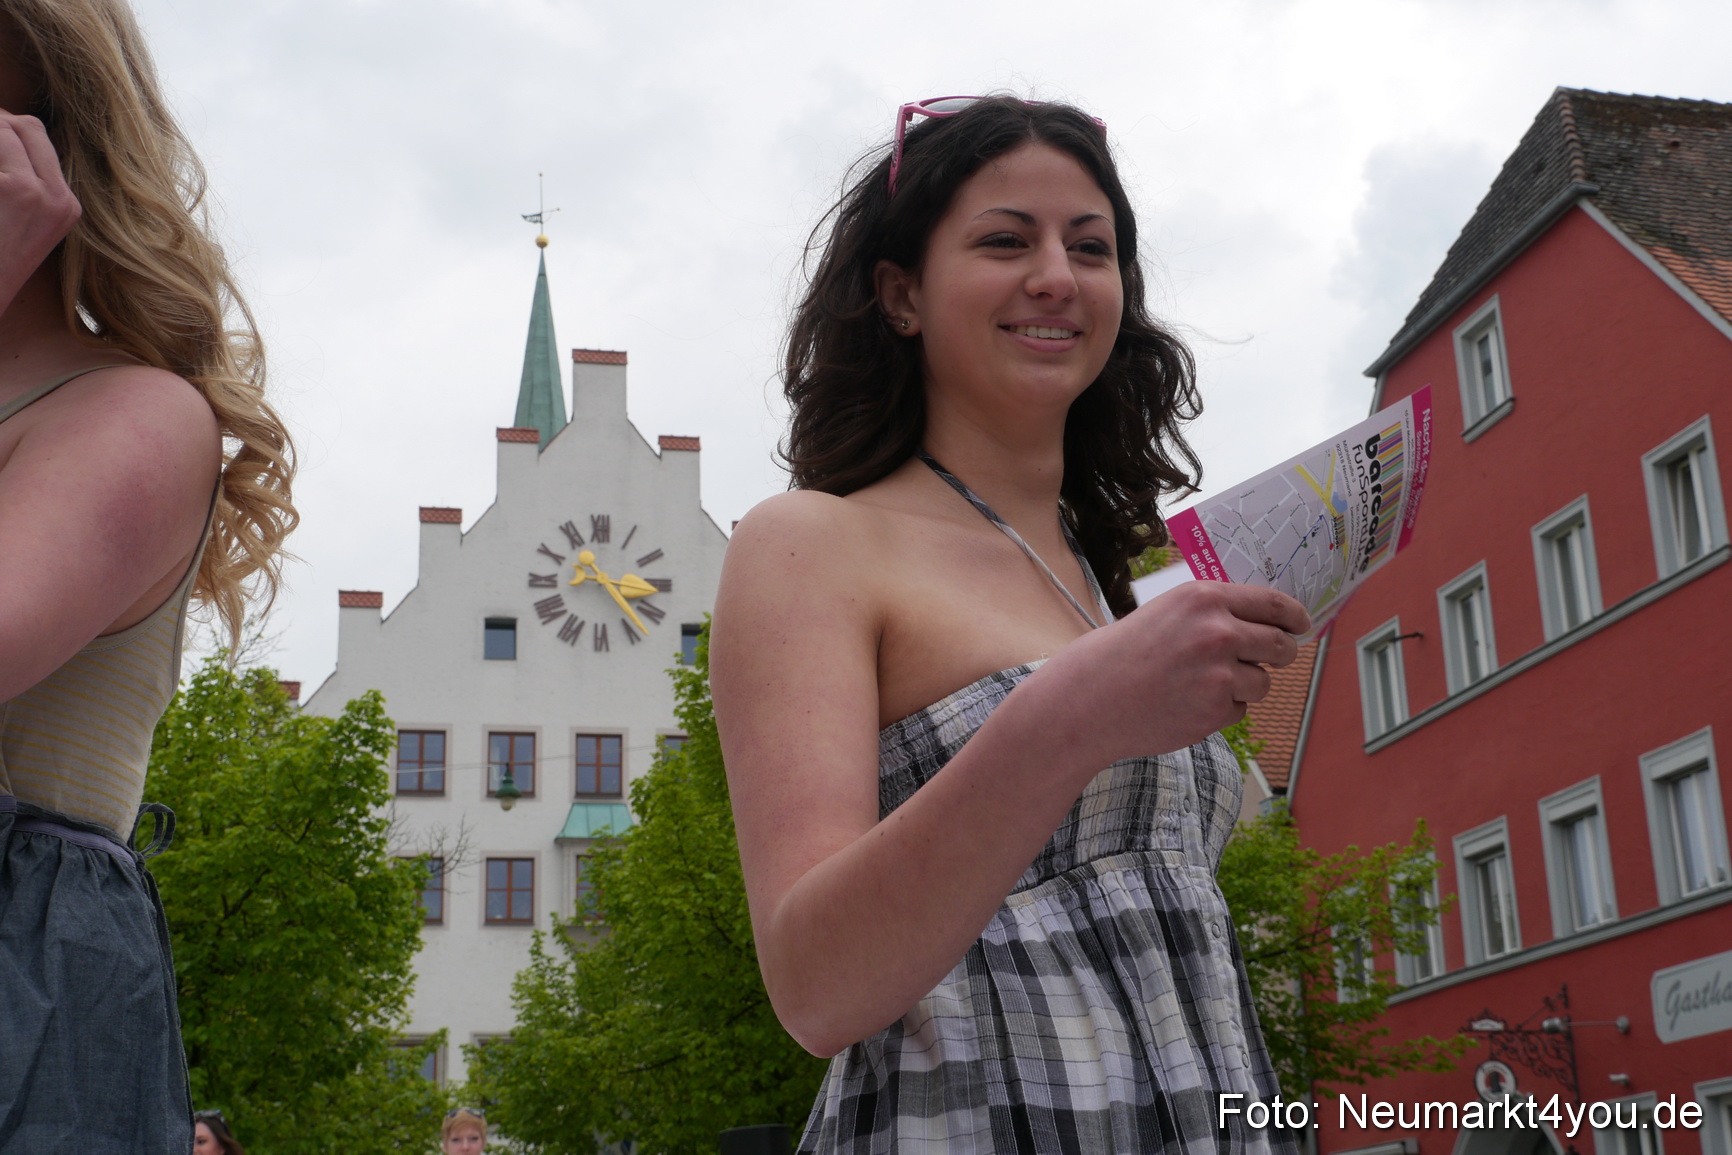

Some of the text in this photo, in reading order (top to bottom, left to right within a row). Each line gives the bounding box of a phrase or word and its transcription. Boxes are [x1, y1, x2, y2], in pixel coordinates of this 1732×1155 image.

[1359, 433, 1381, 574] barcode
[1190, 553, 1210, 580] außer
[1191, 525, 1223, 582] 10% auf das
